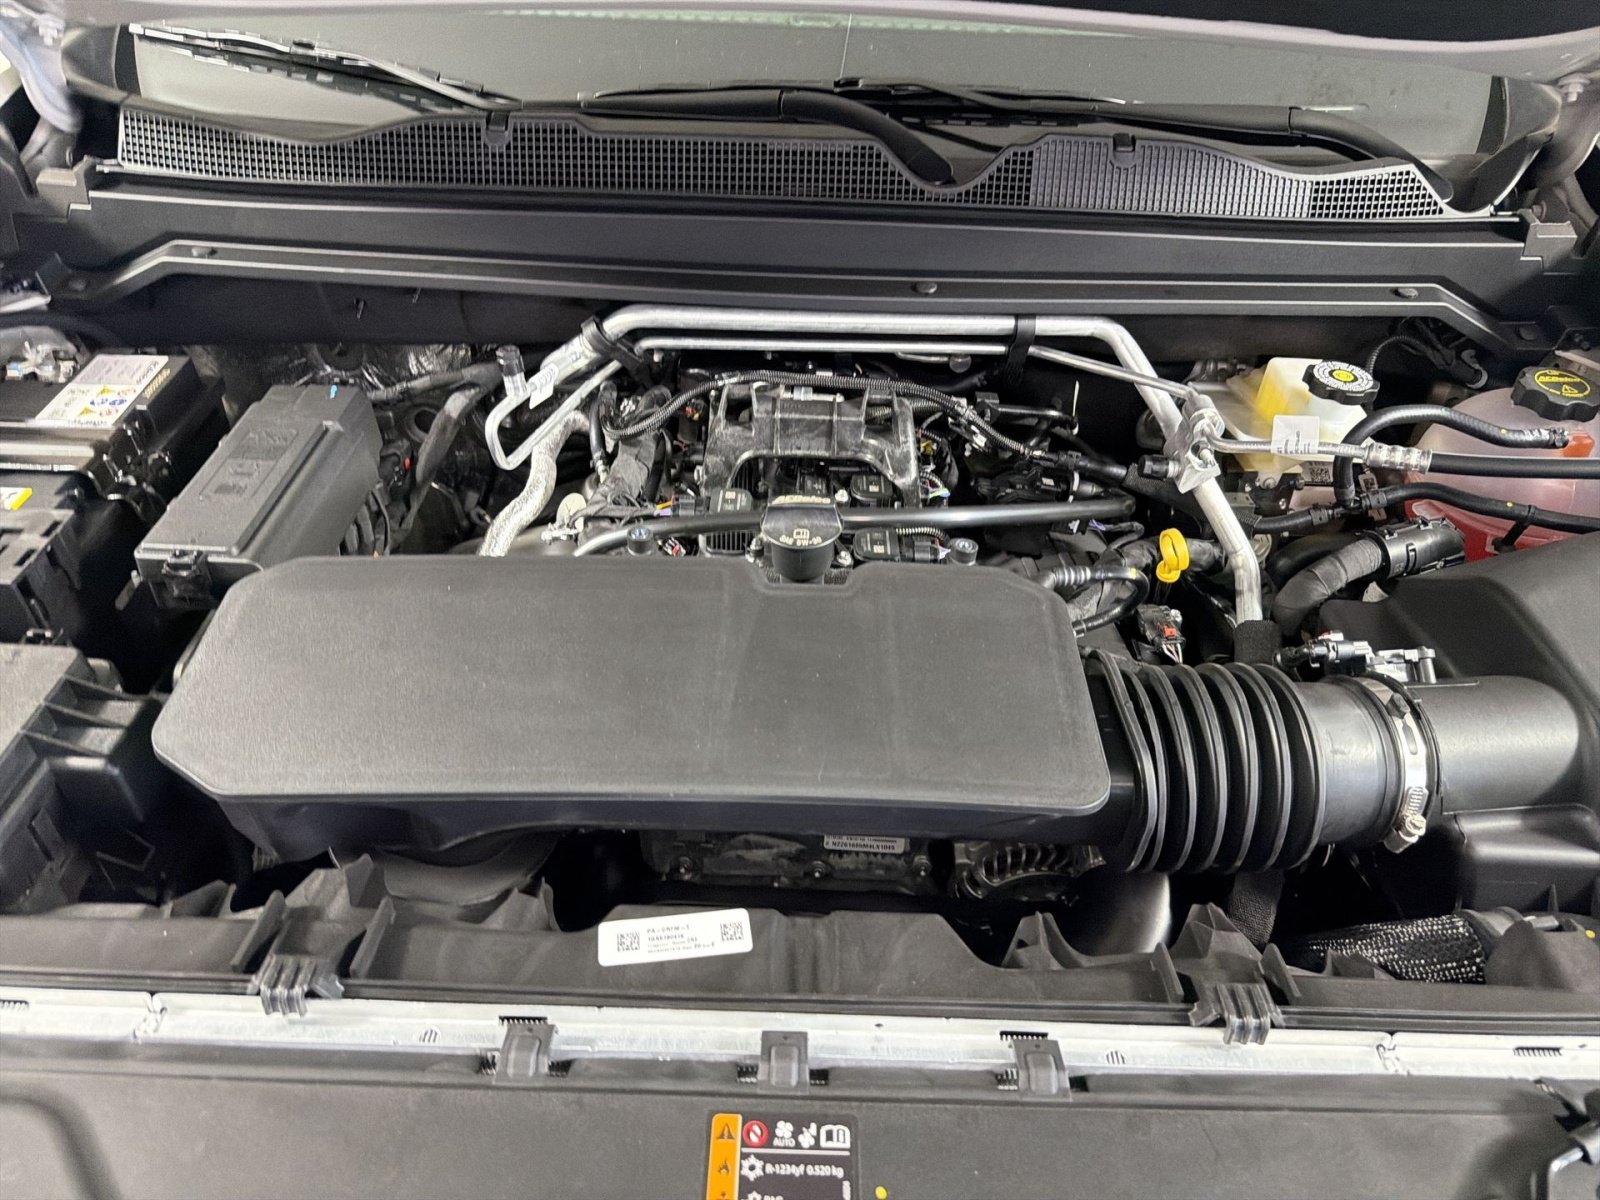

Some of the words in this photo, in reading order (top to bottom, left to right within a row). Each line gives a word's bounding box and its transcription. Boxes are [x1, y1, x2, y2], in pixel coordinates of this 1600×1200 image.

[771, 494, 831, 504] ACDelco
[772, 1137, 795, 1147] AUTO
[831, 1165, 844, 1178] kg
